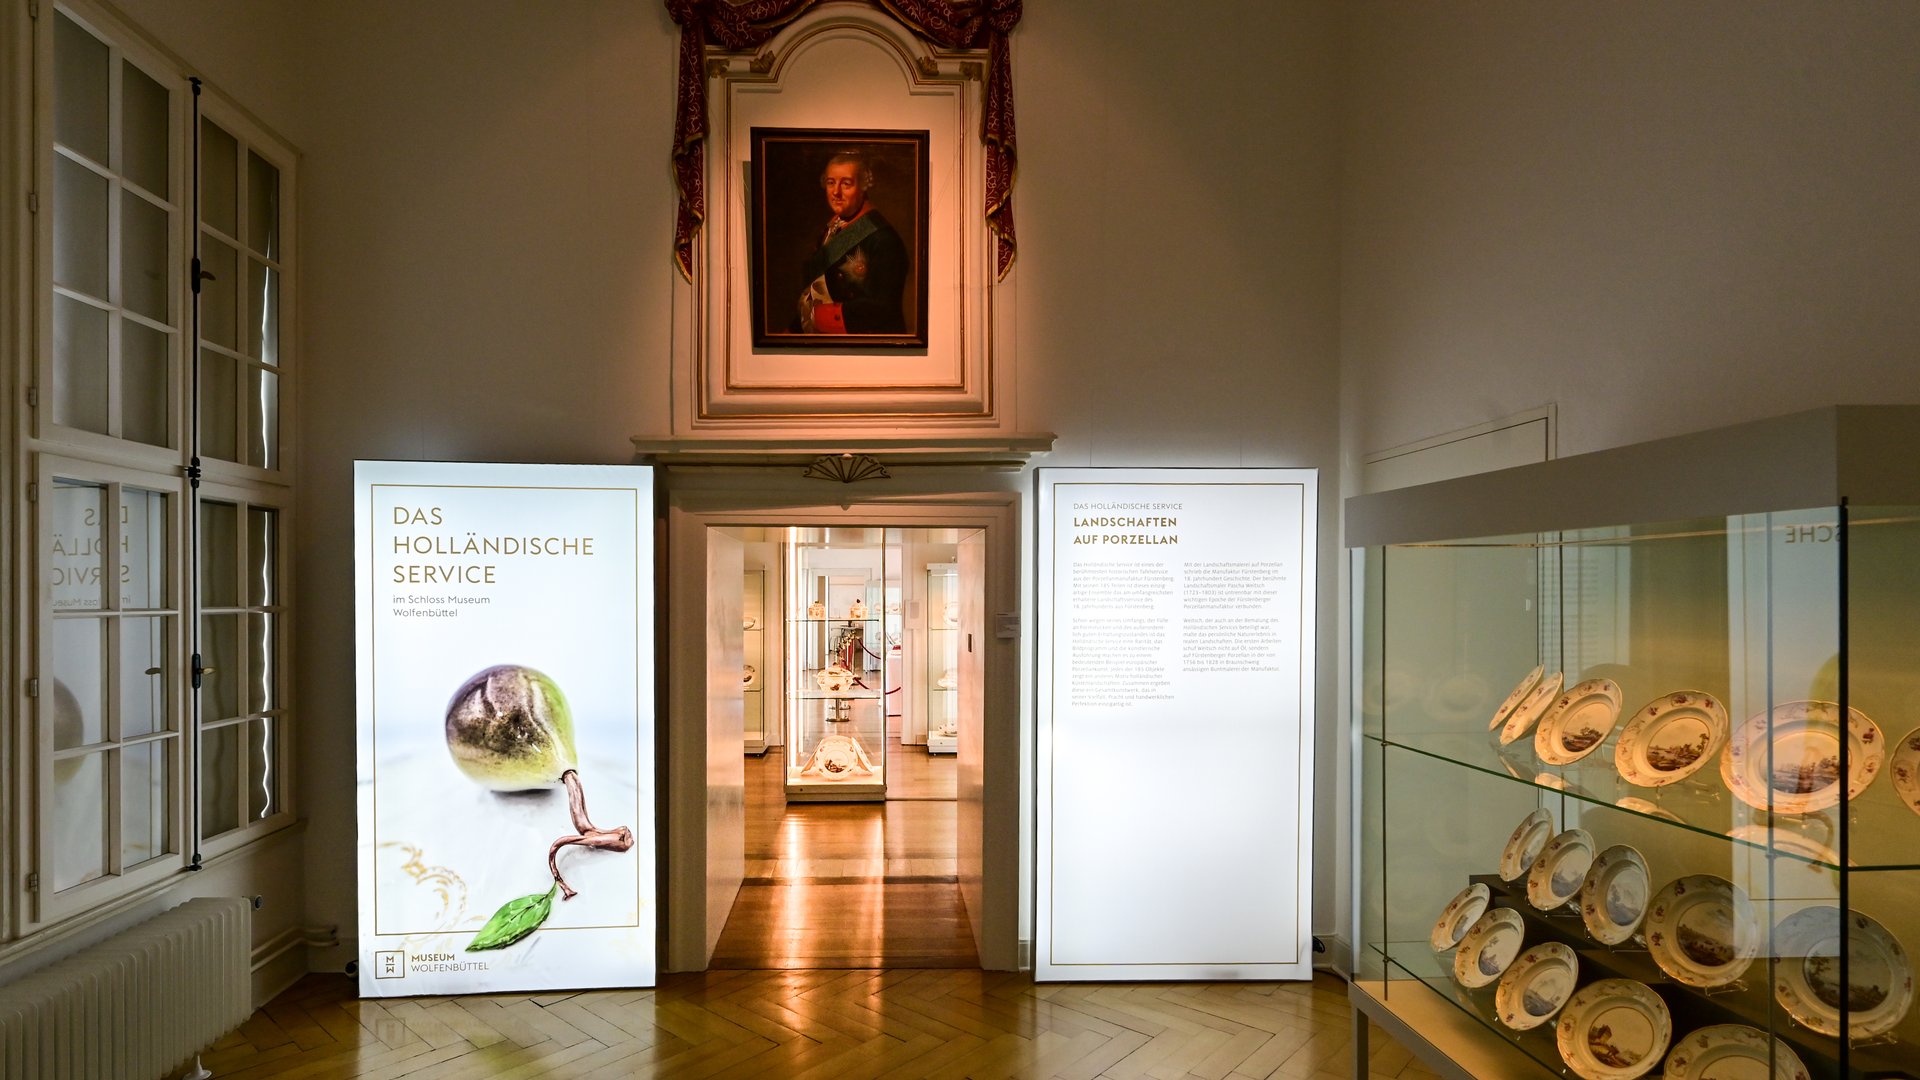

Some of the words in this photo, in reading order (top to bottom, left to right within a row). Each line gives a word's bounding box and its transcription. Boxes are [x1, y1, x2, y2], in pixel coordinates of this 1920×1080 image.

[1091, 502, 1150, 510] HOLLÄNDISCHE
[394, 506, 443, 525] DAS
[1073, 517, 1177, 527] LANDSCHAFTEN
[394, 532, 594, 555] HOLLÄNDISCHE
[1073, 535, 1098, 544] AUF
[1103, 535, 1178, 544] PORZELLAN
[393, 565, 496, 584] SERVICE
[393, 595, 405, 604] im
[408, 595, 445, 604] Schloss
[448, 596, 490, 604] Museum
[392, 608, 458, 617] Wolfenbüttel
[411, 962, 489, 972] WOLFENBÜTTEL
